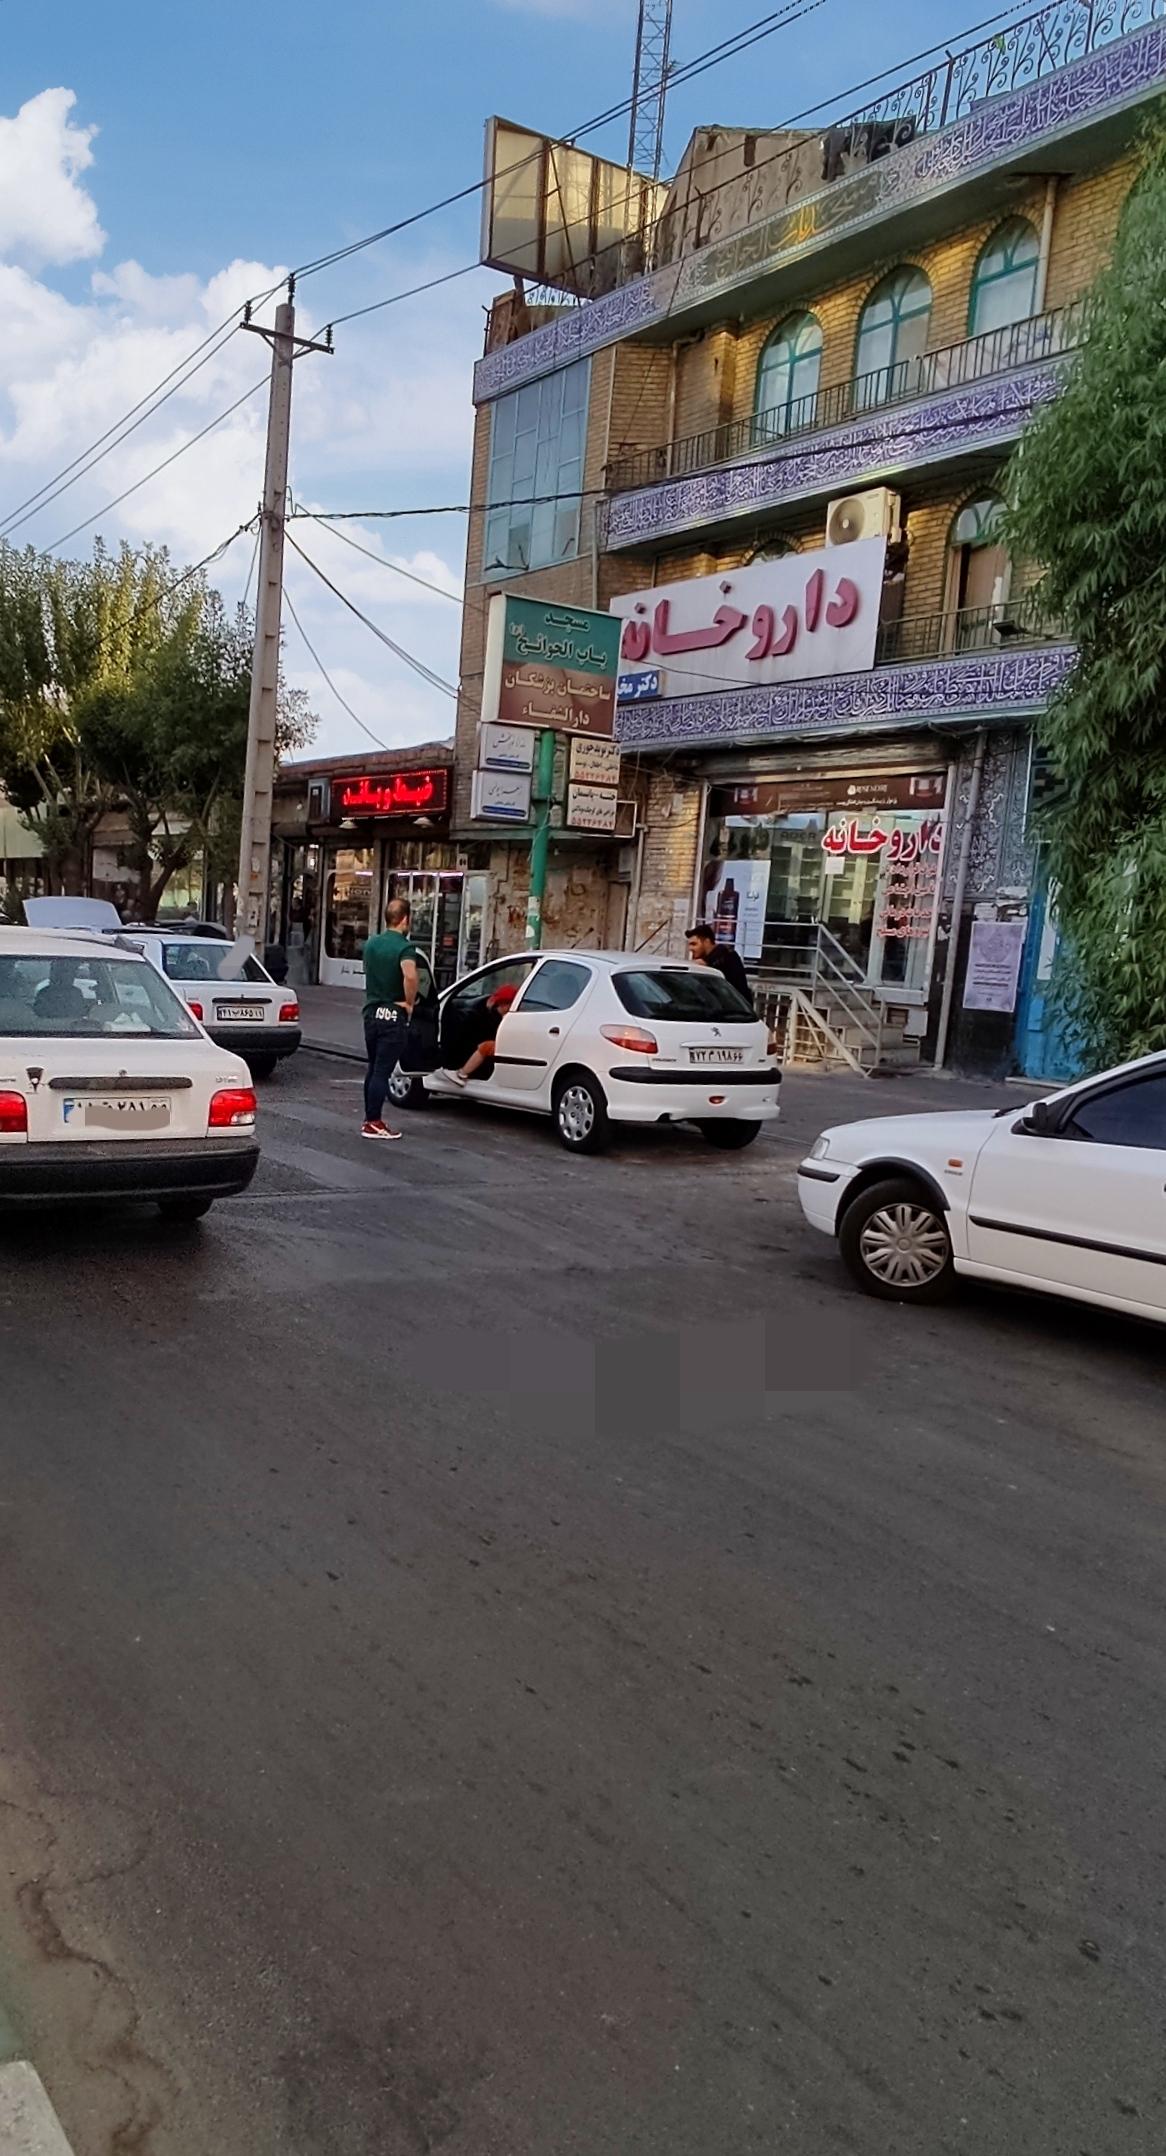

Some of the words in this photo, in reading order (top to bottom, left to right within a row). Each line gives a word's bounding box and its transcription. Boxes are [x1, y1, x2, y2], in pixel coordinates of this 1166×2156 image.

[544, 611, 591, 633] مسجد
[576, 644, 608, 670] باب
[504, 670, 555, 695] پزشکان
[556, 679, 611, 701] ساختمان
[634, 674, 658, 698] دکتر
